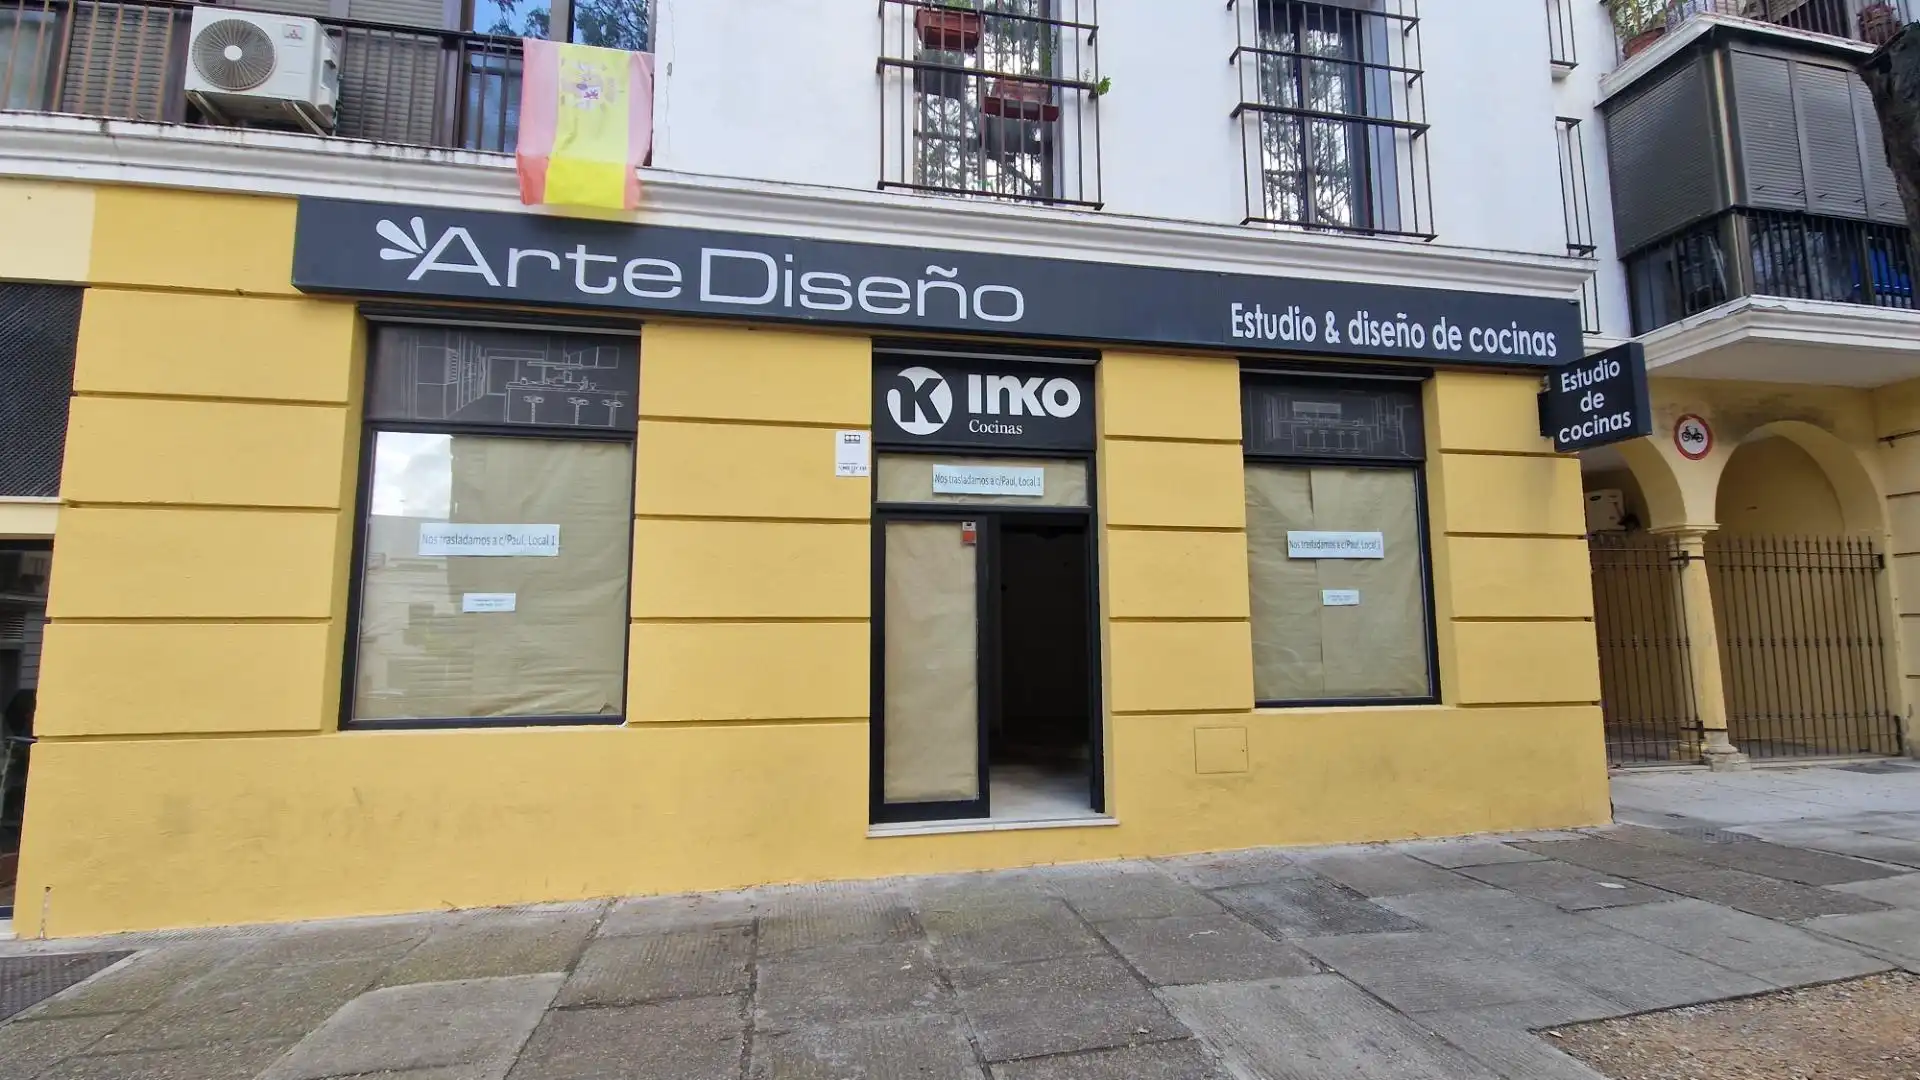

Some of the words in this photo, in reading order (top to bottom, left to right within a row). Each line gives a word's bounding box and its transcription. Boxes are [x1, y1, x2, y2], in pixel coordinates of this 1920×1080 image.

[406, 225, 682, 299] Arte
[699, 246, 1026, 323] Diseño
[1231, 302, 1317, 343] Estudio
[1325, 310, 1341, 345] &
[1348, 309, 1426, 350] diseño
[1432, 315, 1462, 352] de
[1469, 320, 1557, 358] cocinas
[1560, 358, 1620, 393] Estudio
[1580, 390, 1605, 413] de
[968, 419, 1023, 436] Cocinas
[1559, 411, 1632, 443] cocinas
[934, 473, 948, 485] Nos
[949, 474, 989, 487] trasladamos
[1019, 475, 1036, 487] Local
[422, 533, 438, 545] Nos
[440, 533, 491, 546] trasladamos
[528, 535, 550, 546] Local
